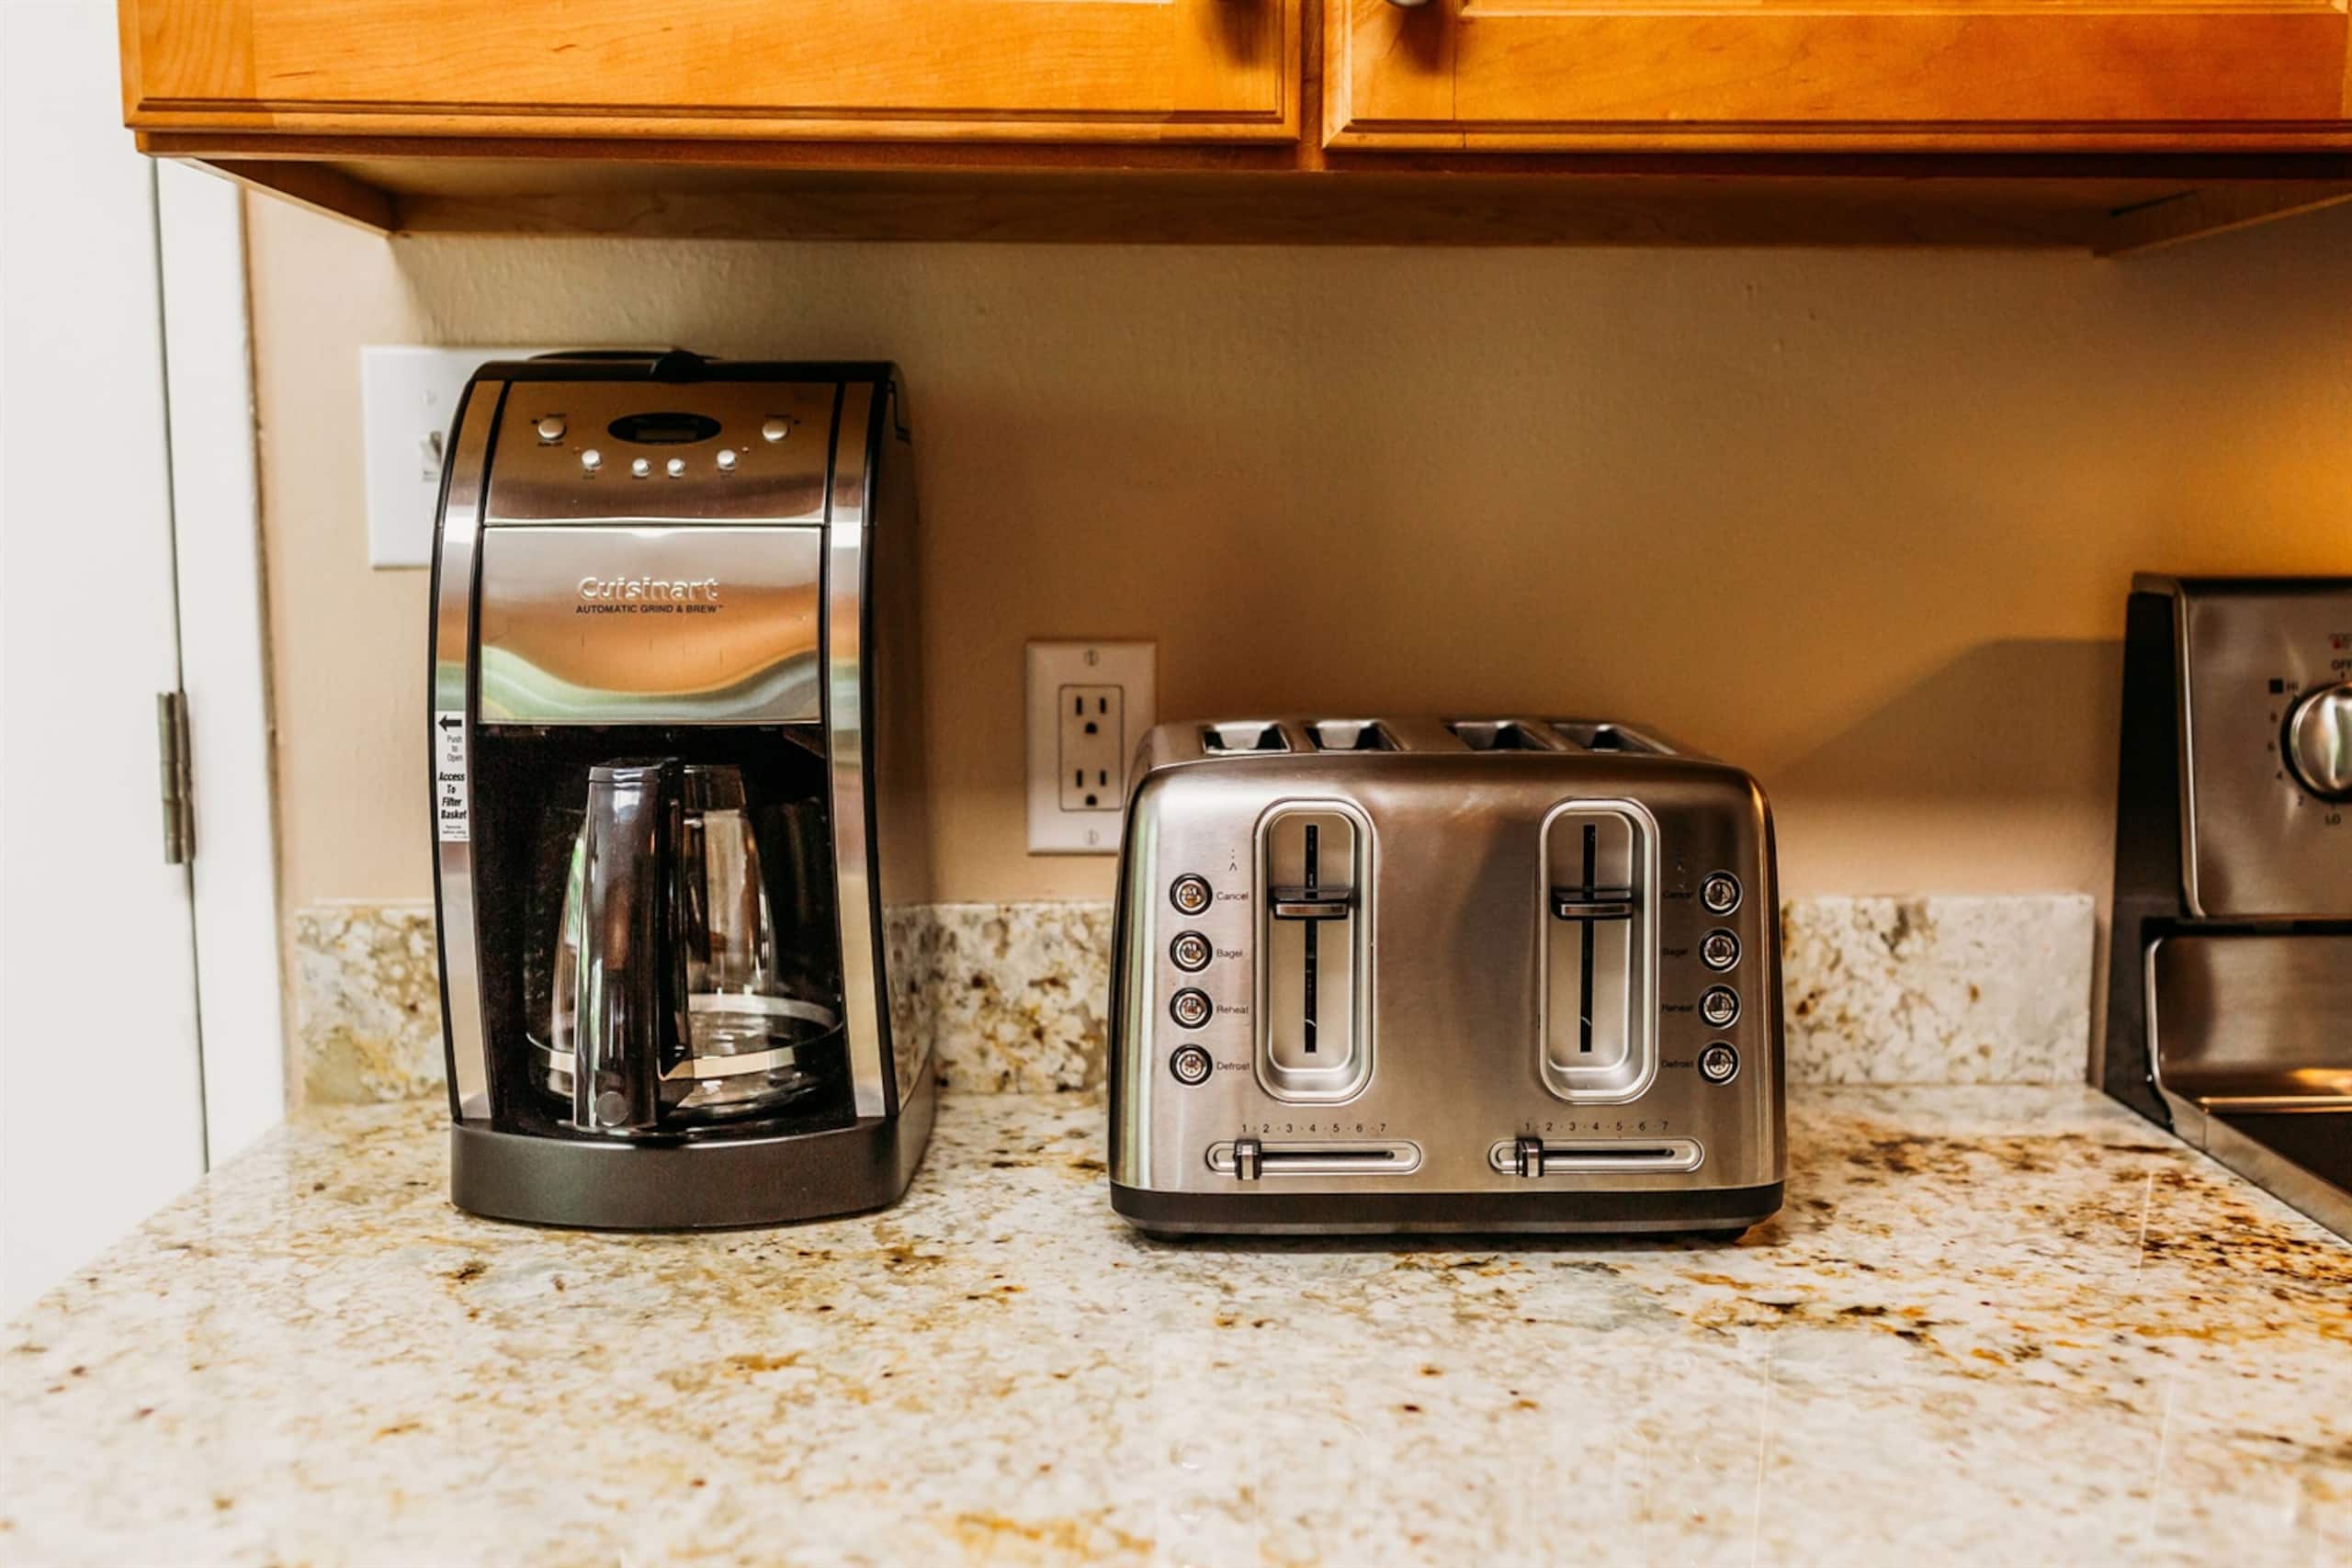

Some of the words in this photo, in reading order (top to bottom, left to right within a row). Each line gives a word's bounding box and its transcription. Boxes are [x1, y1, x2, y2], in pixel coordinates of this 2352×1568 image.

[577, 576, 719, 601] Cuisinart
[576, 604, 638, 614] AUTOMATIC
[640, 604, 673, 614] GRIND
[675, 604, 683, 614] &
[447, 735, 462, 743] Push
[447, 753, 463, 762] Open
[439, 772, 465, 781] Access
[447, 784, 457, 794] To
[442, 796, 462, 807] Filter
[440, 809, 467, 819] Basket
[1216, 892, 1249, 900] Cancel
[1216, 949, 1243, 959] Bagel
[1216, 1006, 1250, 1015] Reheat
[1216, 1062, 1250, 1071] Defrost
[1263, 1124, 1270, 1133] 2
[1286, 1124, 1293, 1133] 3
[1309, 1124, 1317, 1133] 4
[1332, 1124, 1340, 1133] 5
[1356, 1124, 1363, 1133] 6
[1380, 1124, 1387, 1133] 7
[1546, 1122, 1553, 1131] 2
[1569, 1122, 1577, 1131] 3
[1592, 1122, 1600, 1131] 4
[1616, 1122, 1623, 1131] 5
[1639, 1122, 1646, 1131] 6
[1661, 1122, 1669, 1131] 7
